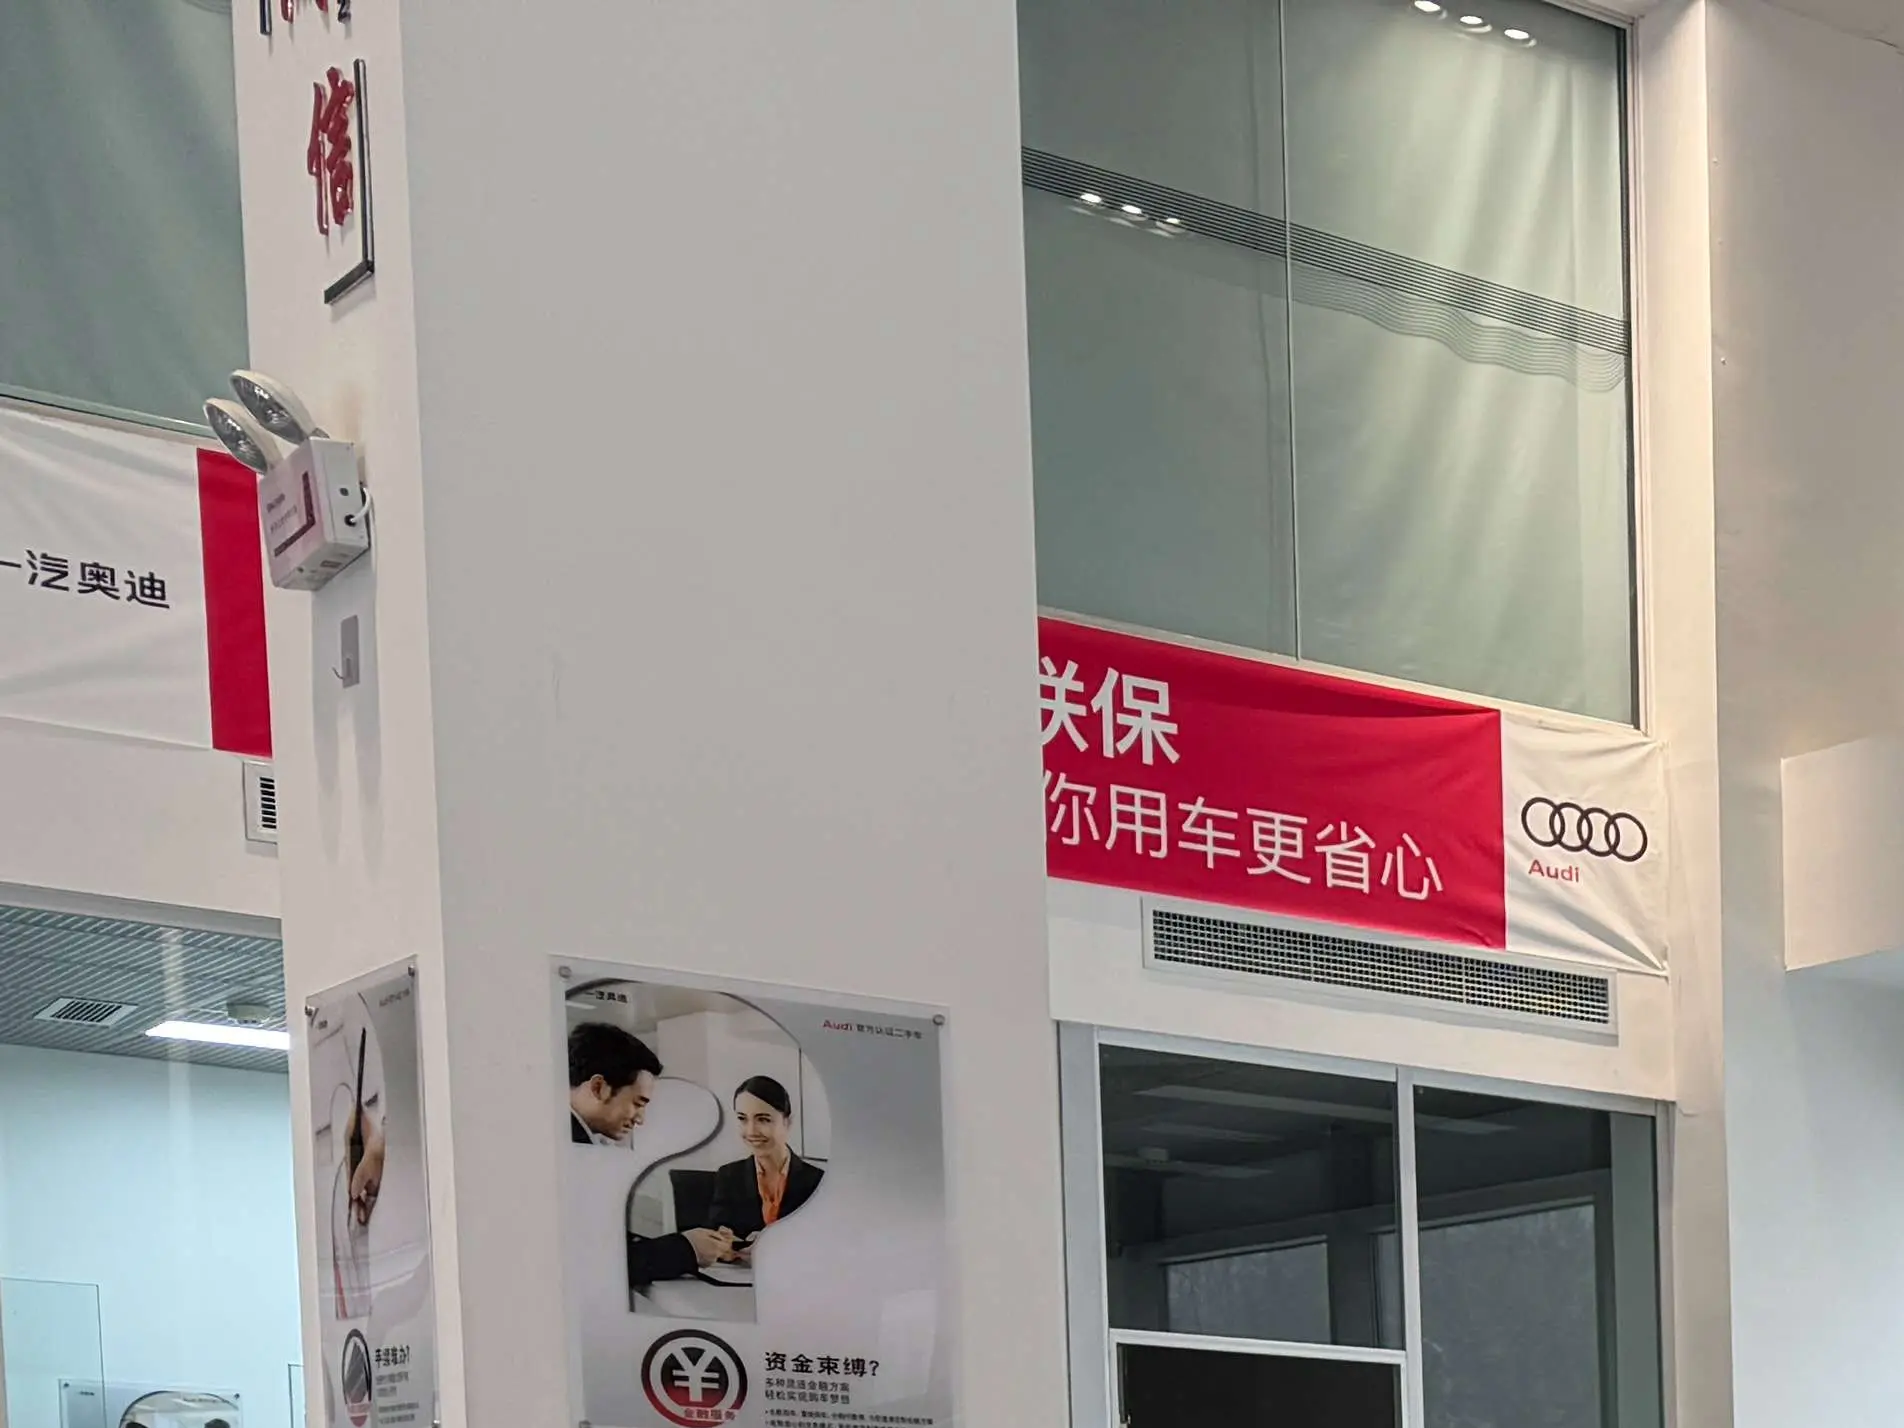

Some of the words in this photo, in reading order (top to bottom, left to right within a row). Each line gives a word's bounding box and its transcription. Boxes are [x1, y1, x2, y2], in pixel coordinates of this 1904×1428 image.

[0, 549, 170, 609] 一汽奥迪
[1528, 858, 1581, 885] Audi
[823, 1019, 853, 1031] Audi
